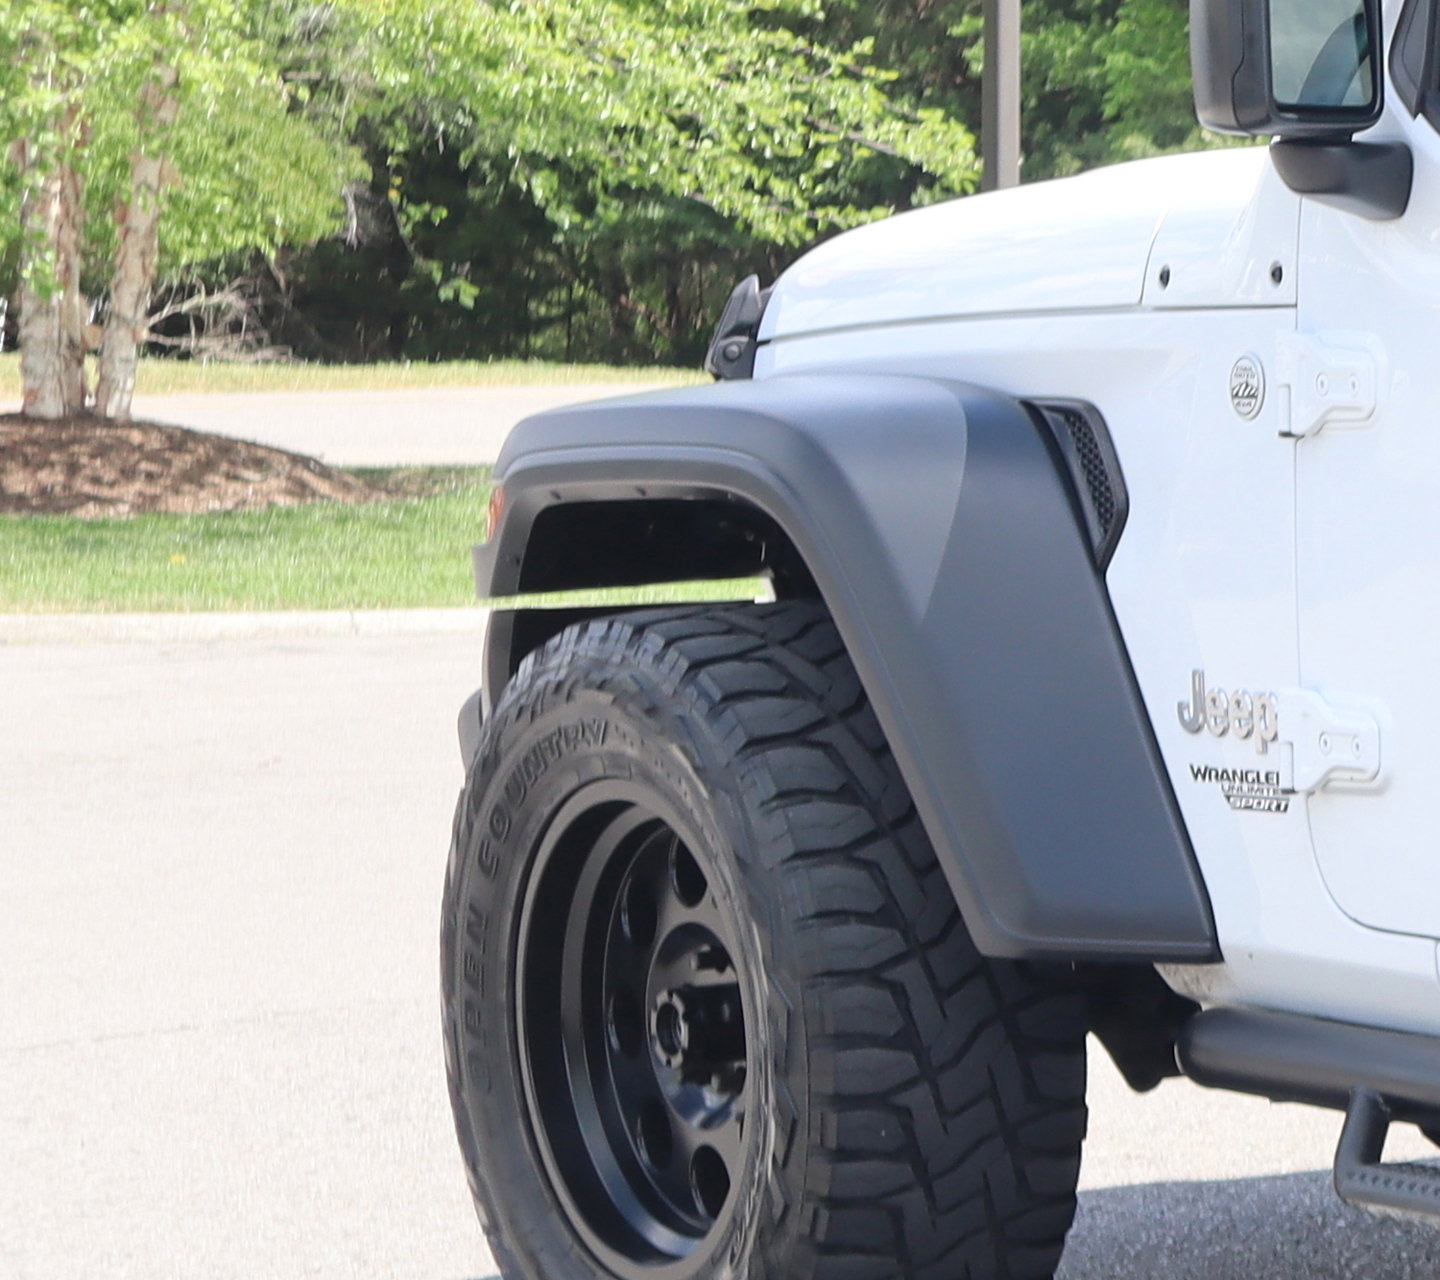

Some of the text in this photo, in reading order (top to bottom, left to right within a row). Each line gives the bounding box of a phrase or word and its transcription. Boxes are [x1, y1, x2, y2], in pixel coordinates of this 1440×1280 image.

[1177, 668, 1279, 754] Jeep
[477, 718, 609, 881] COUNTRY
[1229, 795, 1288, 813] SPORT
